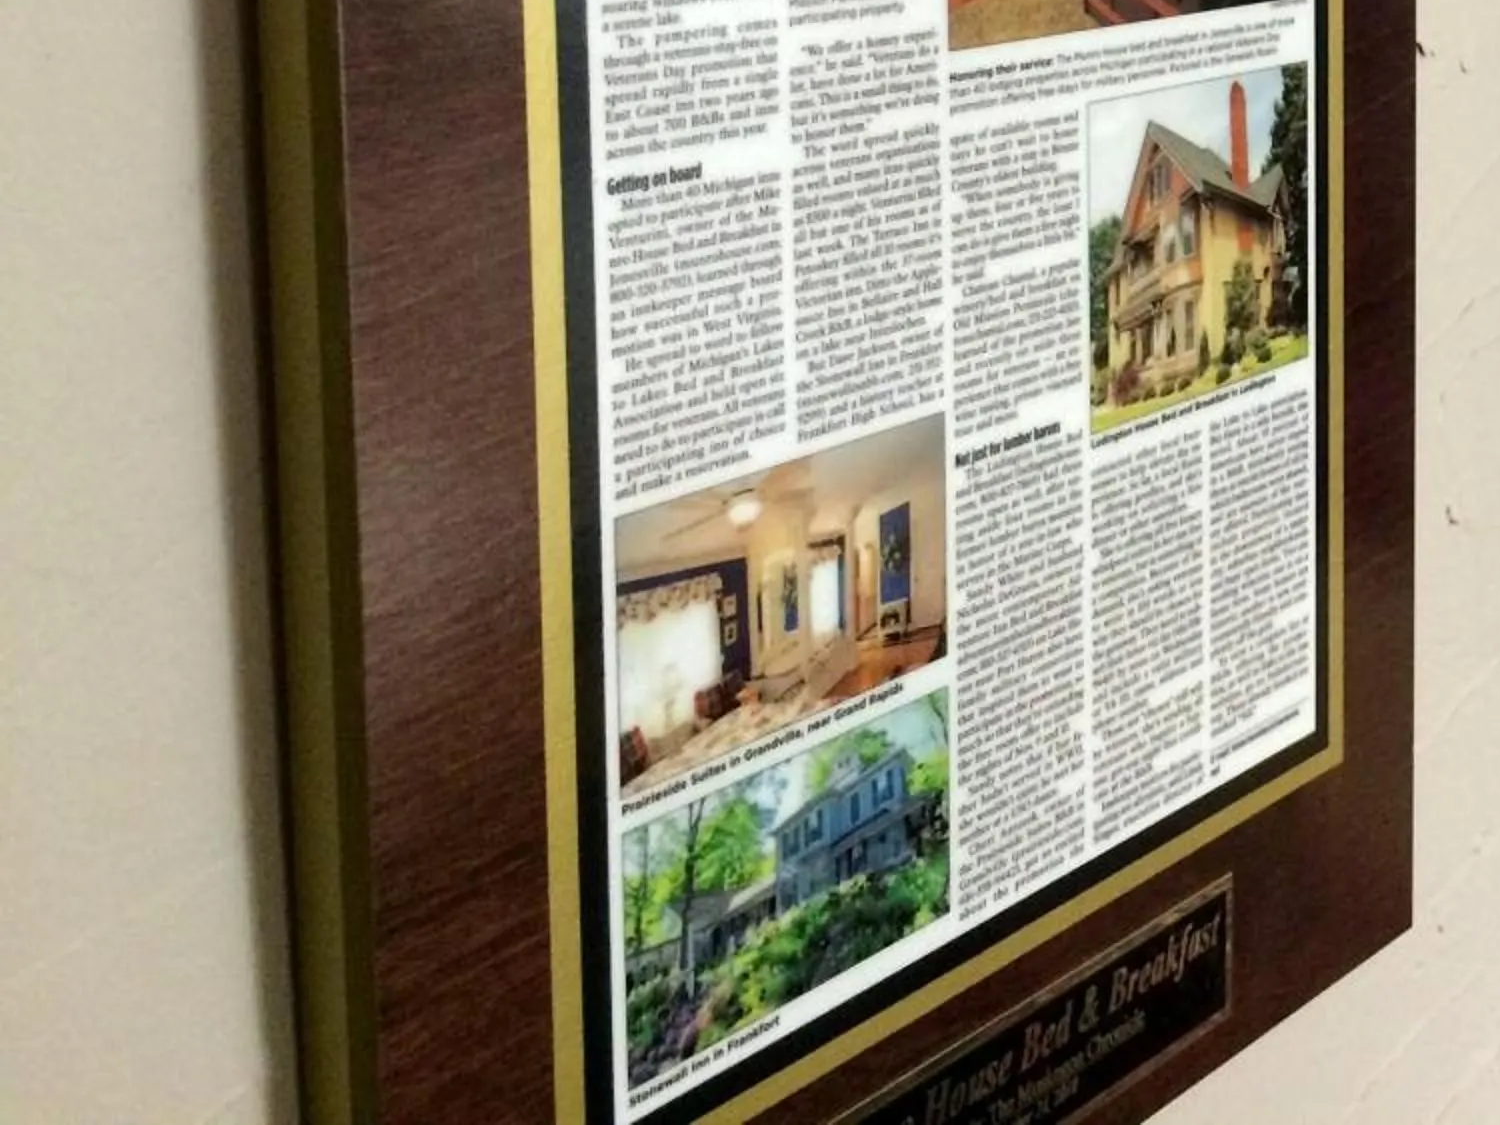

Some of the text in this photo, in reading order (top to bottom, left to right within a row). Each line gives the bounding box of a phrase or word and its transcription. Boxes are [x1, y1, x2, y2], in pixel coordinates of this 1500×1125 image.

[949, 67, 994, 84] Honoring
[995, 63, 1018, 76] their
[606, 162, 703, 196] Getting on board
[955, 452, 971, 468] Not
[621, 780, 688, 817] Prairieside
[690, 762, 727, 786] Suites
[729, 755, 742, 768] in
[807, 715, 832, 734] near
[833, 697, 867, 721] Grand
[868, 682, 904, 706] Rapids
[924, 911, 1222, 1125] House Bed & Breakfast
[628, 1015, 780, 1108] Stonewall Inn in Frankfort
